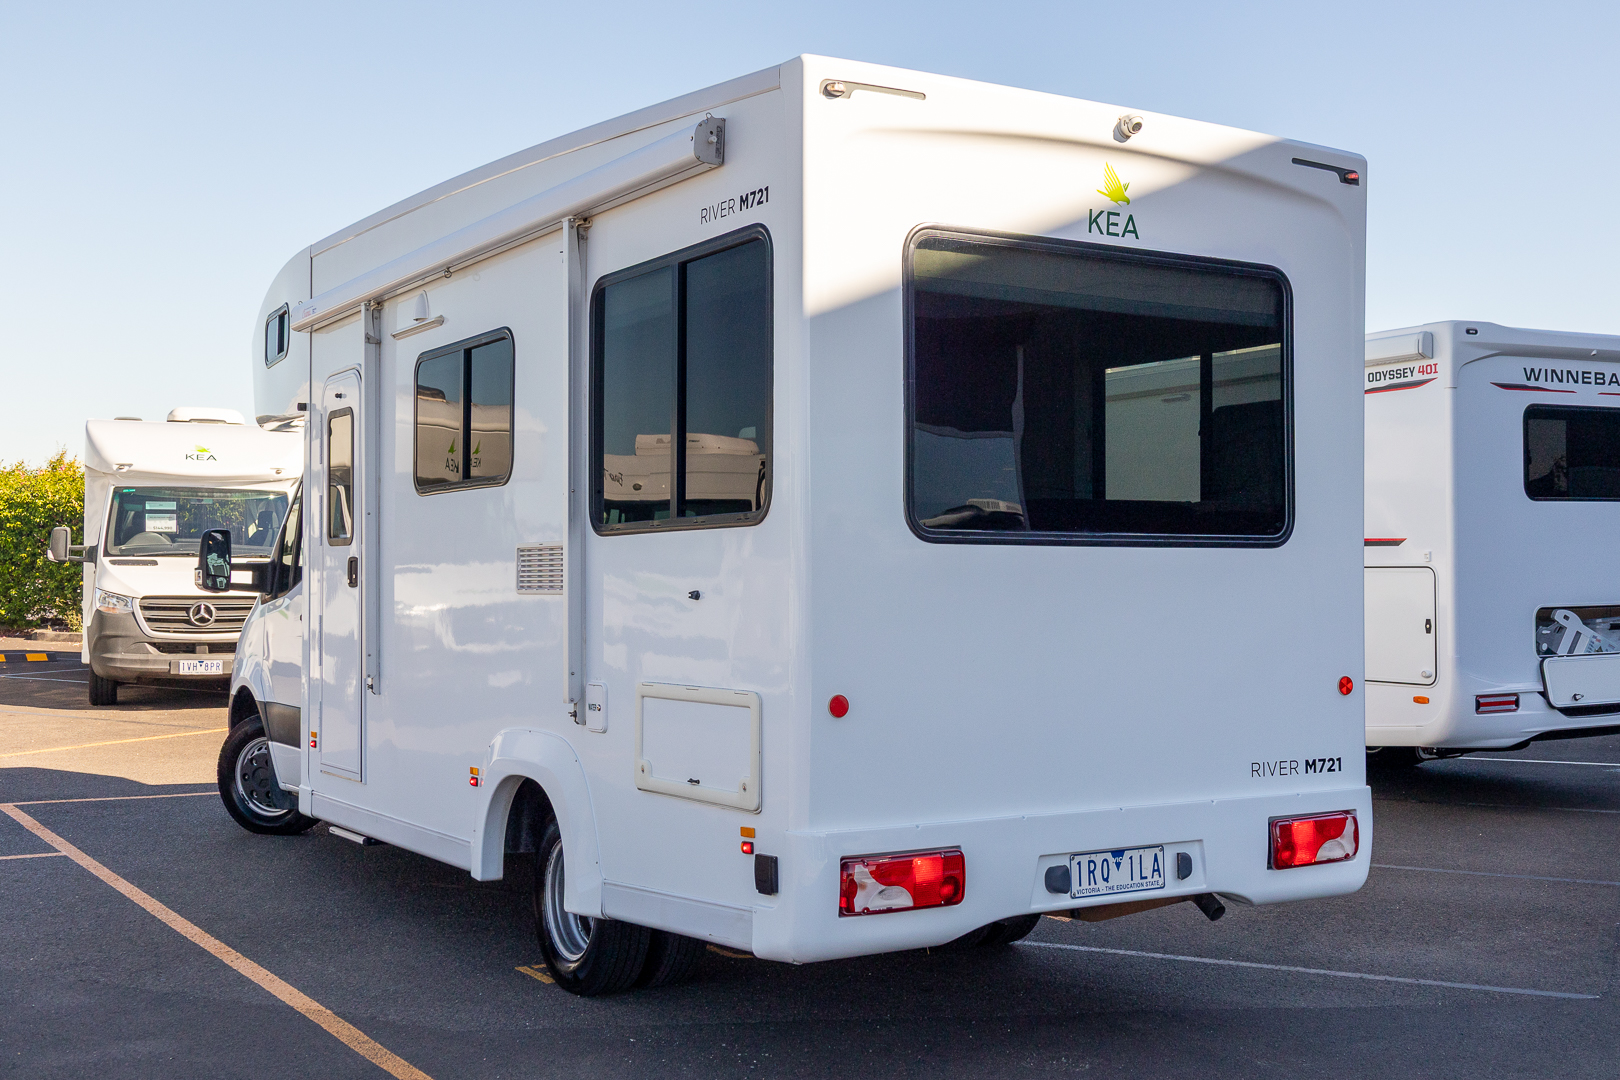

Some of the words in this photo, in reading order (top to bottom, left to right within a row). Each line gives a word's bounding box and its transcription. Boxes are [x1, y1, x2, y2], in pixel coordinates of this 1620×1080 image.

[700, 198, 736, 225] RIVER
[739, 185, 769, 212] M721
[1088, 208, 1140, 240] KEA
[1367, 366, 1416, 383] ODYSSEY
[1523, 367, 1620, 387] WINNEBA
[185, 453, 218, 462] KEA
[204, 662, 221, 671] 8PR
[1251, 759, 1299, 778] RIVER
[1304, 757, 1342, 774] M721
[1076, 858, 1110, 887] 1RQ
[1128, 852, 1162, 881] 1LA
[1076, 887, 1101, 895] VICTORIA
[1116, 882, 1144, 890] EDUCATION
